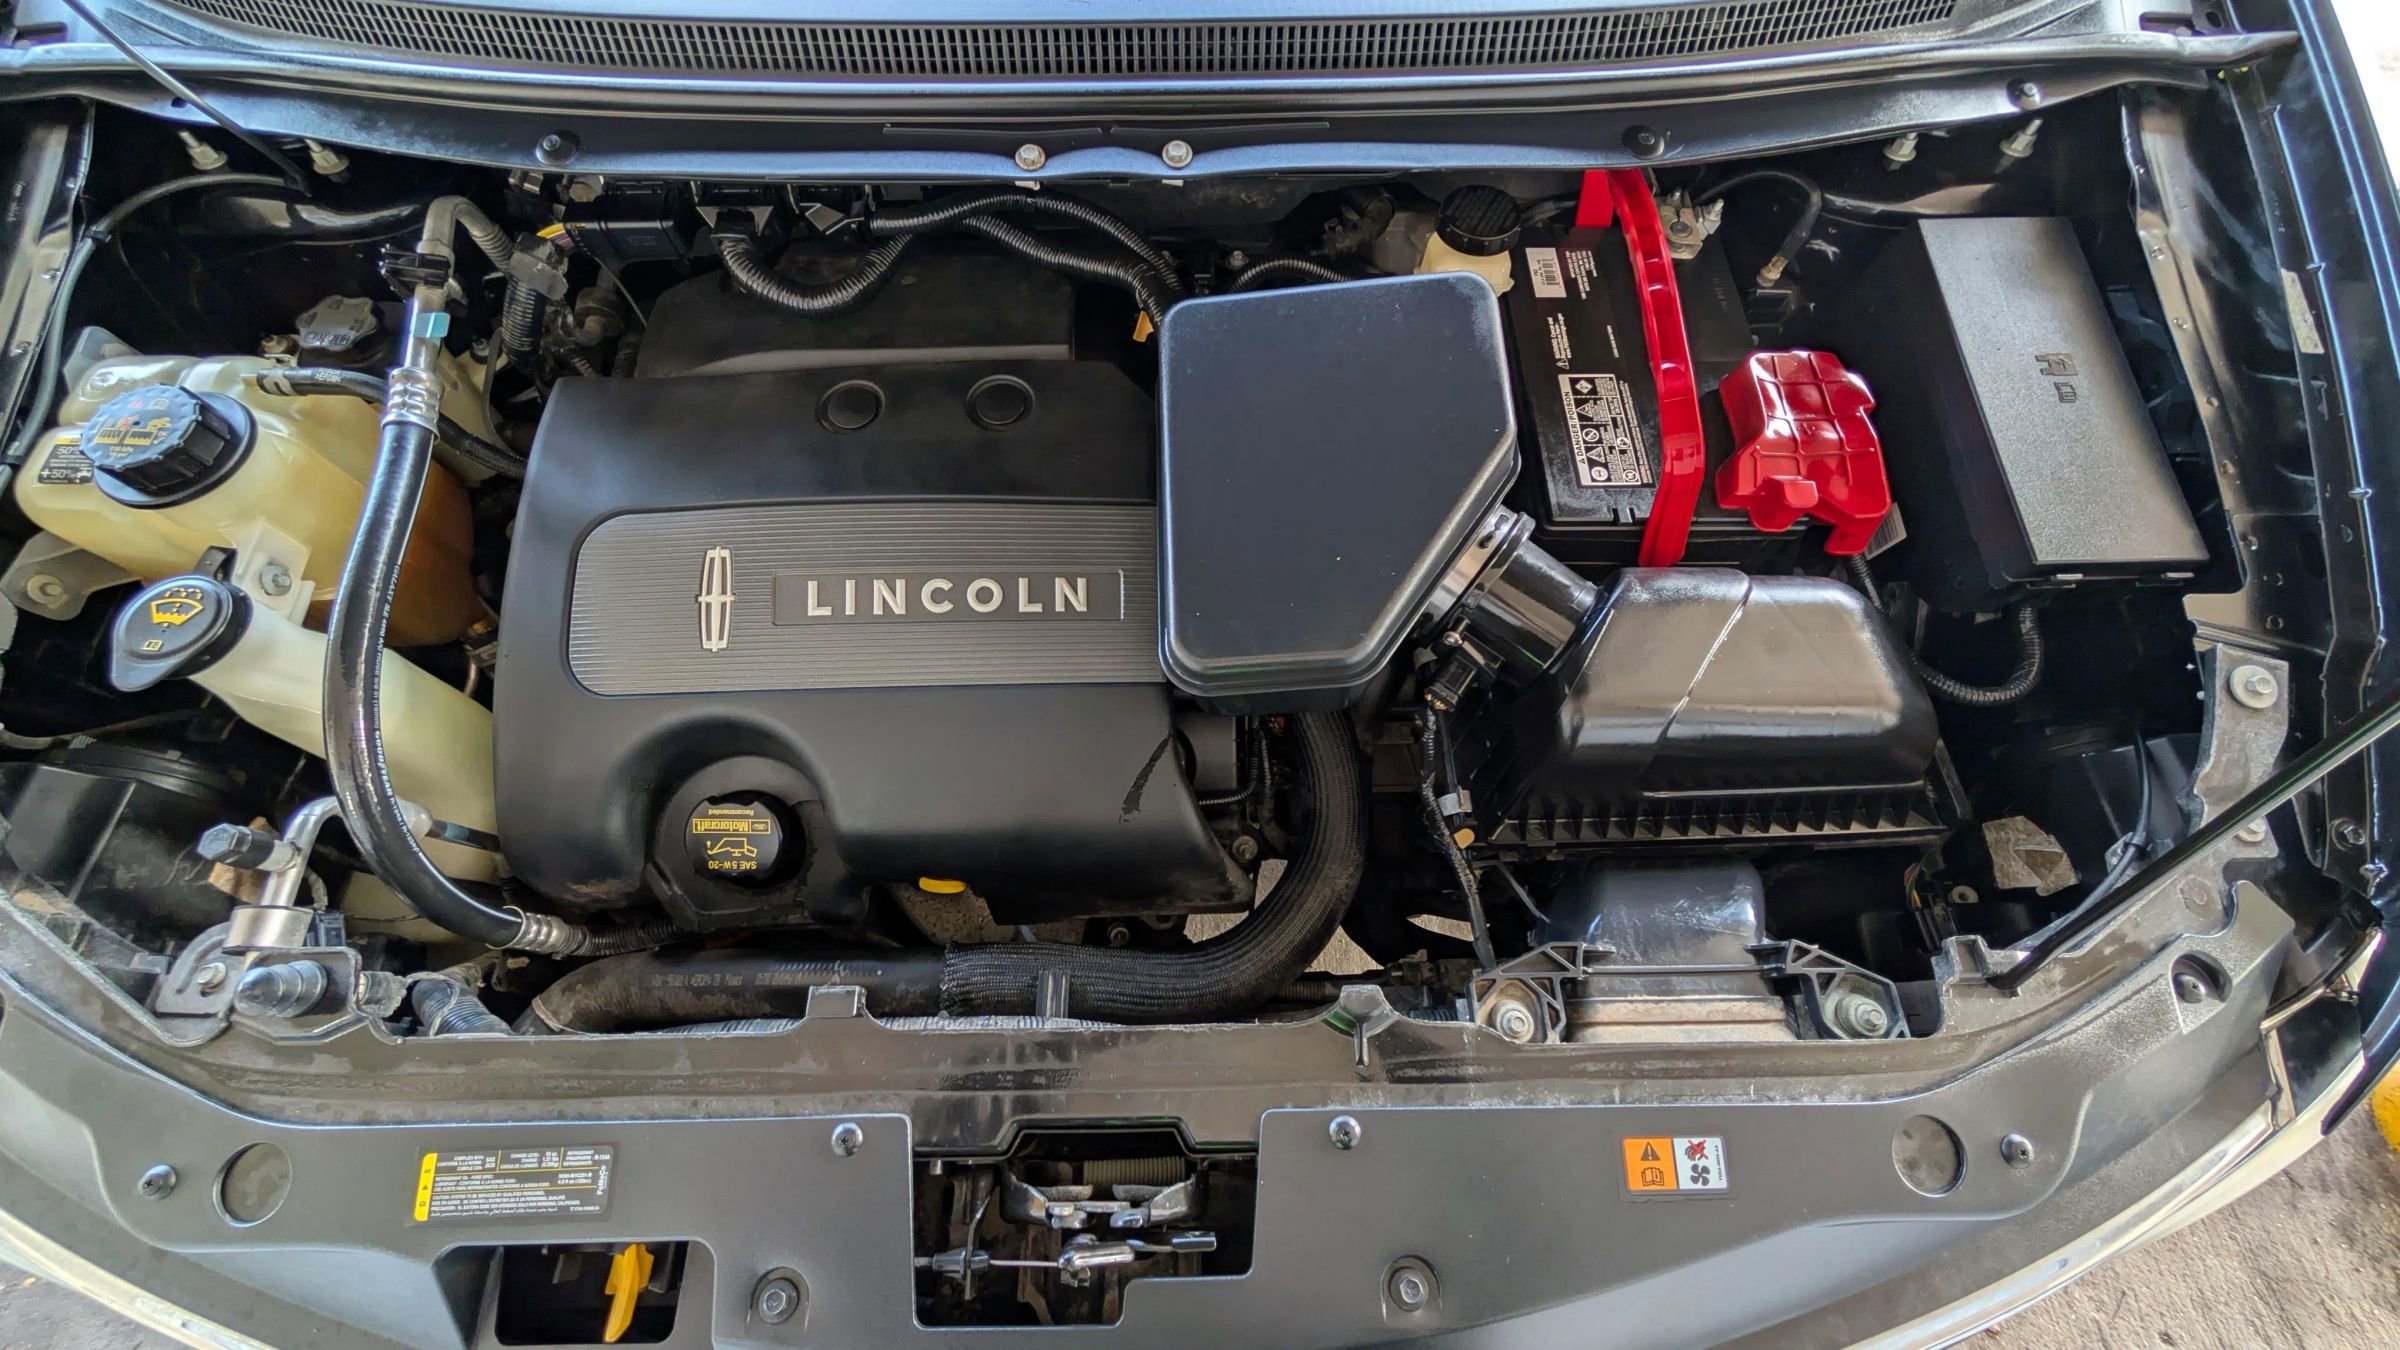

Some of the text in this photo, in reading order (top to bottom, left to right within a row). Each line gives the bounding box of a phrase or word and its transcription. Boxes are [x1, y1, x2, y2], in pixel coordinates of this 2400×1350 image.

[387, 565, 400, 602] GALAXY
[807, 577, 1087, 615] LINCOLN
[374, 731, 393, 796] GOODYEAR
[695, 821, 748, 831] Motorcraft
[708, 860, 757, 869] SAE 5W-20
